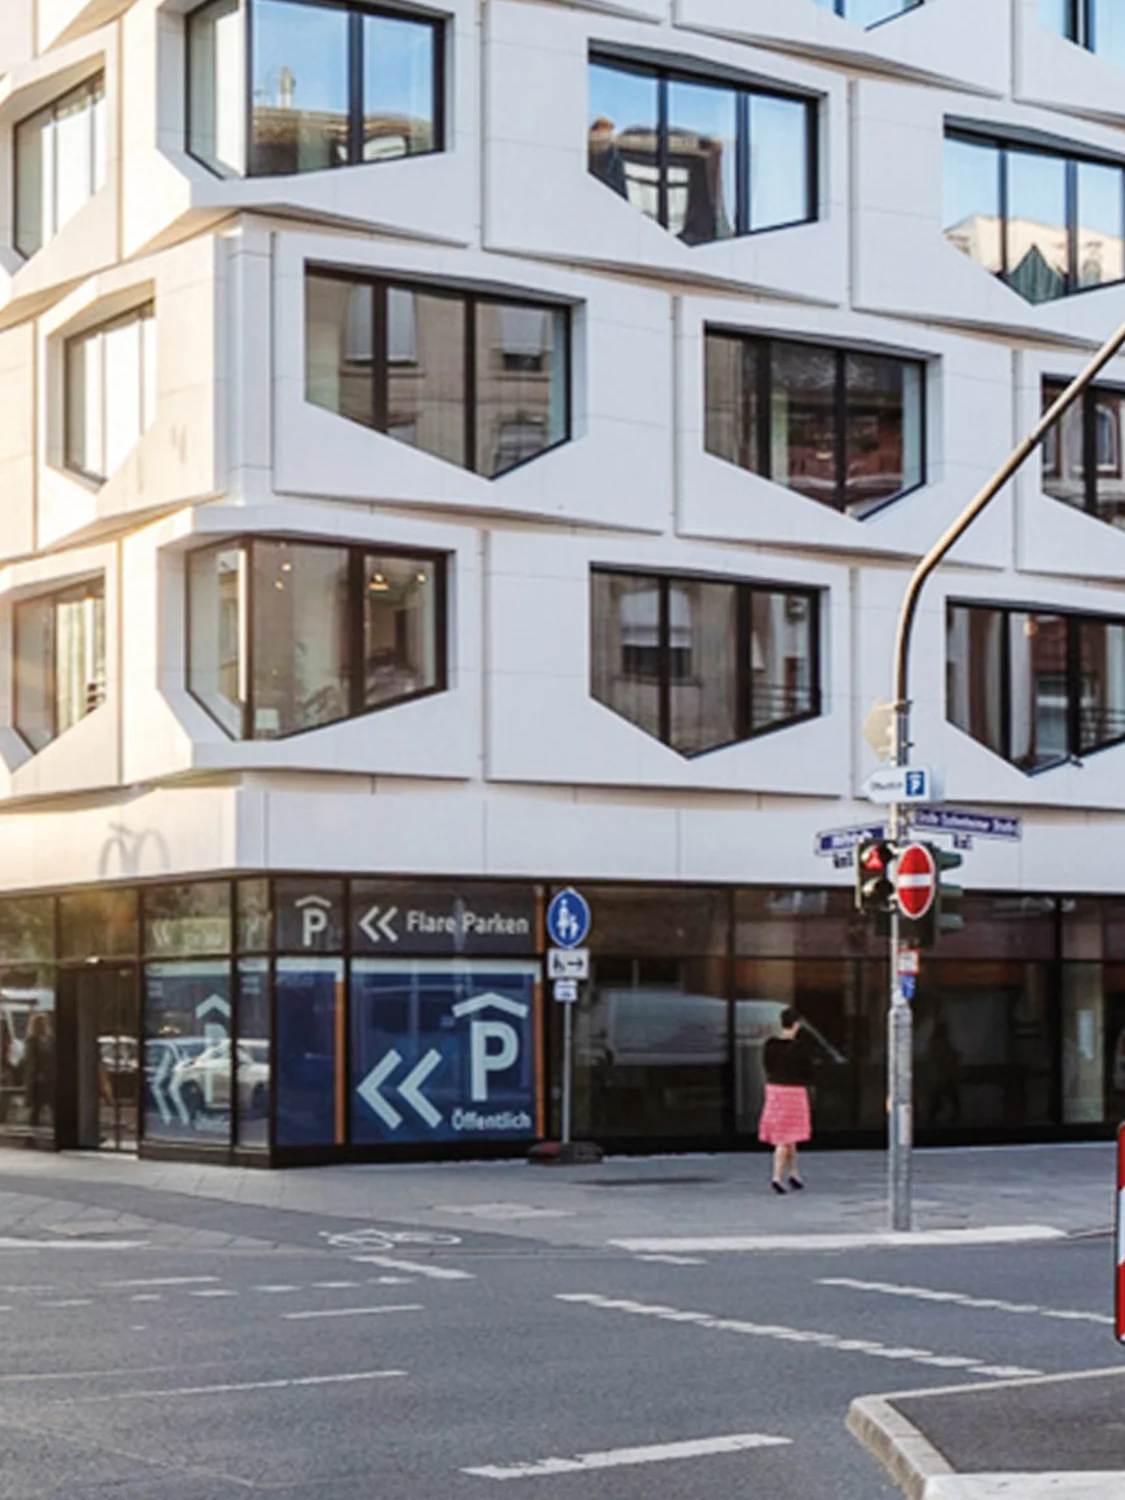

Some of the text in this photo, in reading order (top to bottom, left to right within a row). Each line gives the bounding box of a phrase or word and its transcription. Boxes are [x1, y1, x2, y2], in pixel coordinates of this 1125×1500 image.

[303, 908, 328, 947] P
[406, 910, 529, 934] Flare Parken
[471, 1020, 519, 1101] P
[451, 1106, 532, 1130] Öffentlich
